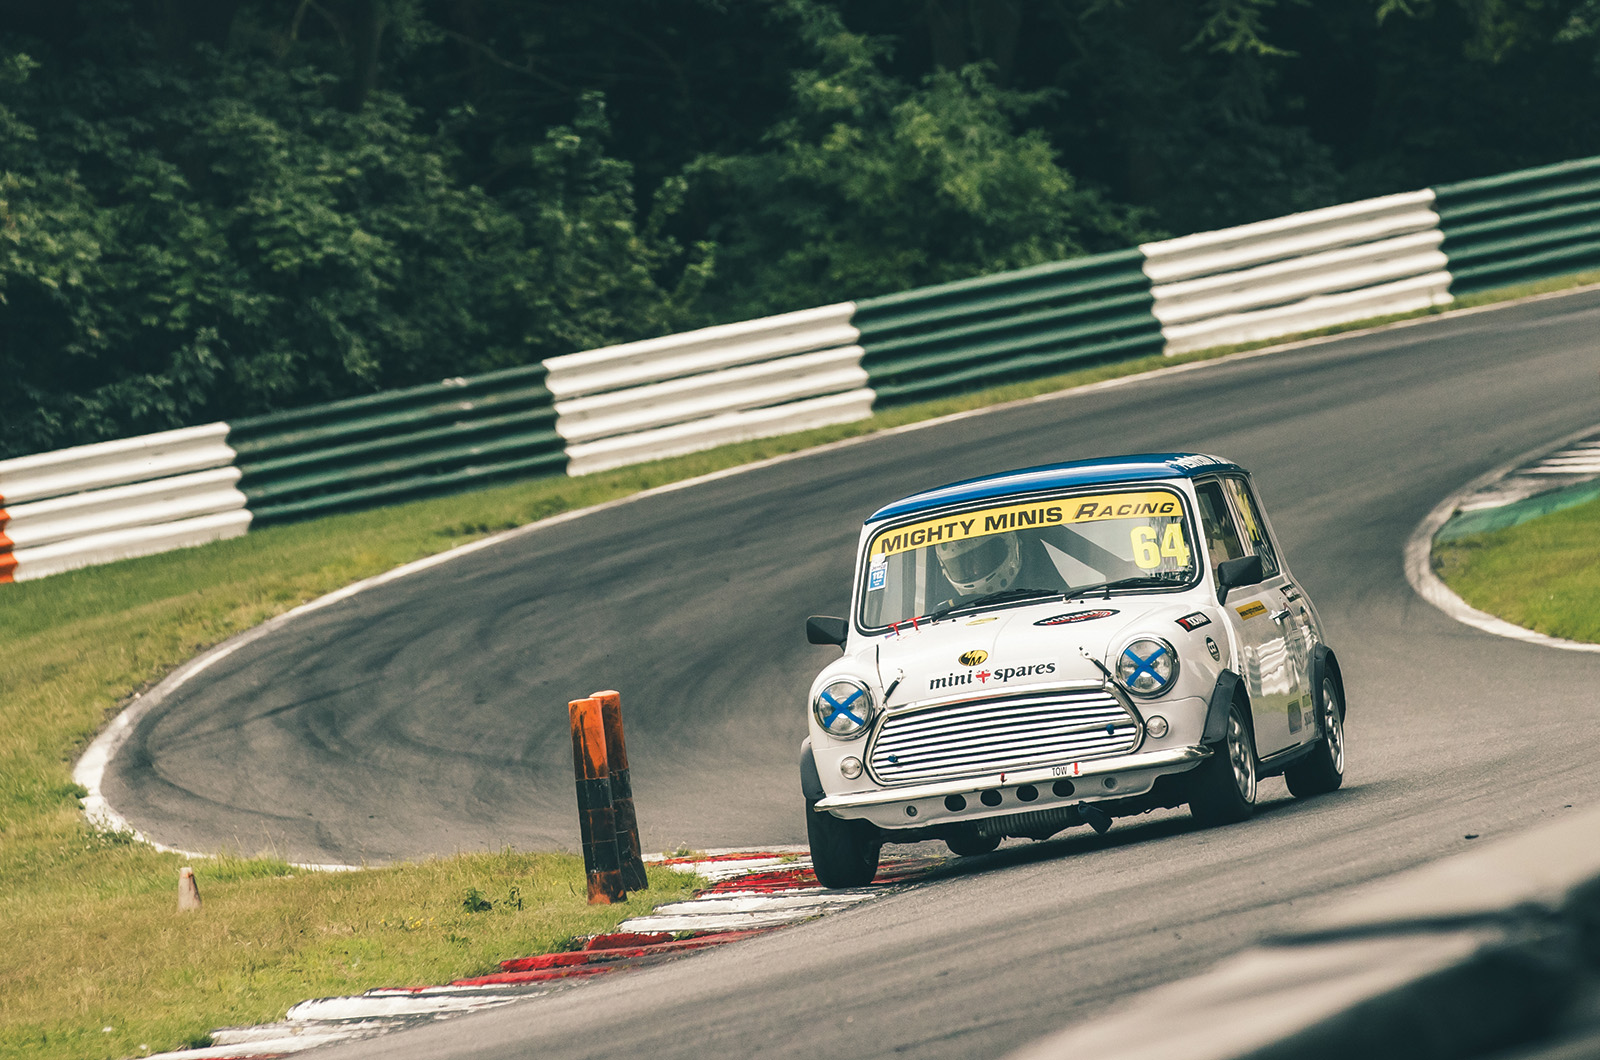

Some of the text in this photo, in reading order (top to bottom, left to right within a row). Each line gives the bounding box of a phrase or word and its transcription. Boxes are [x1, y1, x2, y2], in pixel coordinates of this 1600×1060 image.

[881, 518, 976, 554] MIGHTY
[984, 506, 1063, 532] MINIS
[1130, 523, 1189, 569] 64
[929, 662, 1056, 690] mini spares
[1052, 766, 1067, 776] TOW
